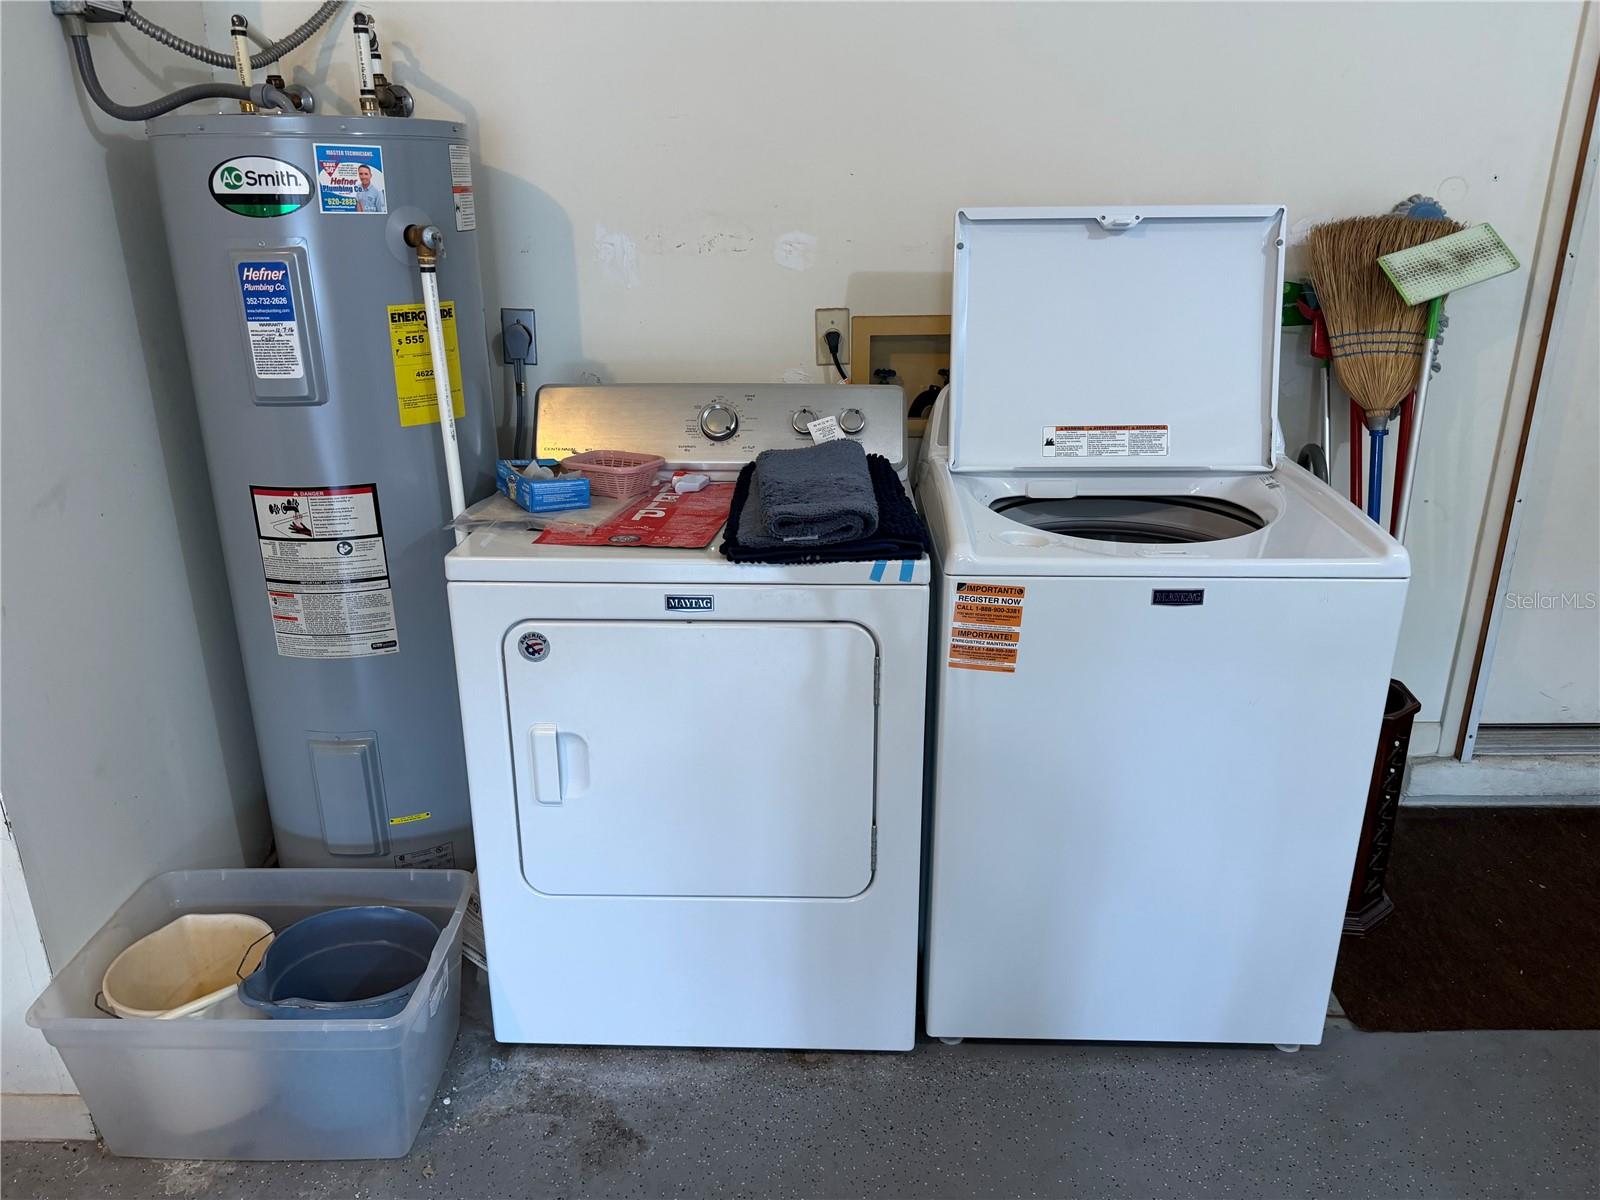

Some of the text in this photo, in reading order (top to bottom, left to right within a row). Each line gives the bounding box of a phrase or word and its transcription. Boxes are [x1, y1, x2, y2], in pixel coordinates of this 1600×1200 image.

[243, 268, 285, 280] Hefner
[244, 283, 274, 292] Plumbing
[405, 335, 424, 344] 555
[966, 585, 1016, 595] IMPORTANT!
[668, 599, 711, 608] MAYTAG
[958, 595, 1022, 605] REGISTER NOW
[519, 633, 547, 645] AMERICA
[958, 630, 1013, 640] IMPORTANTE!
